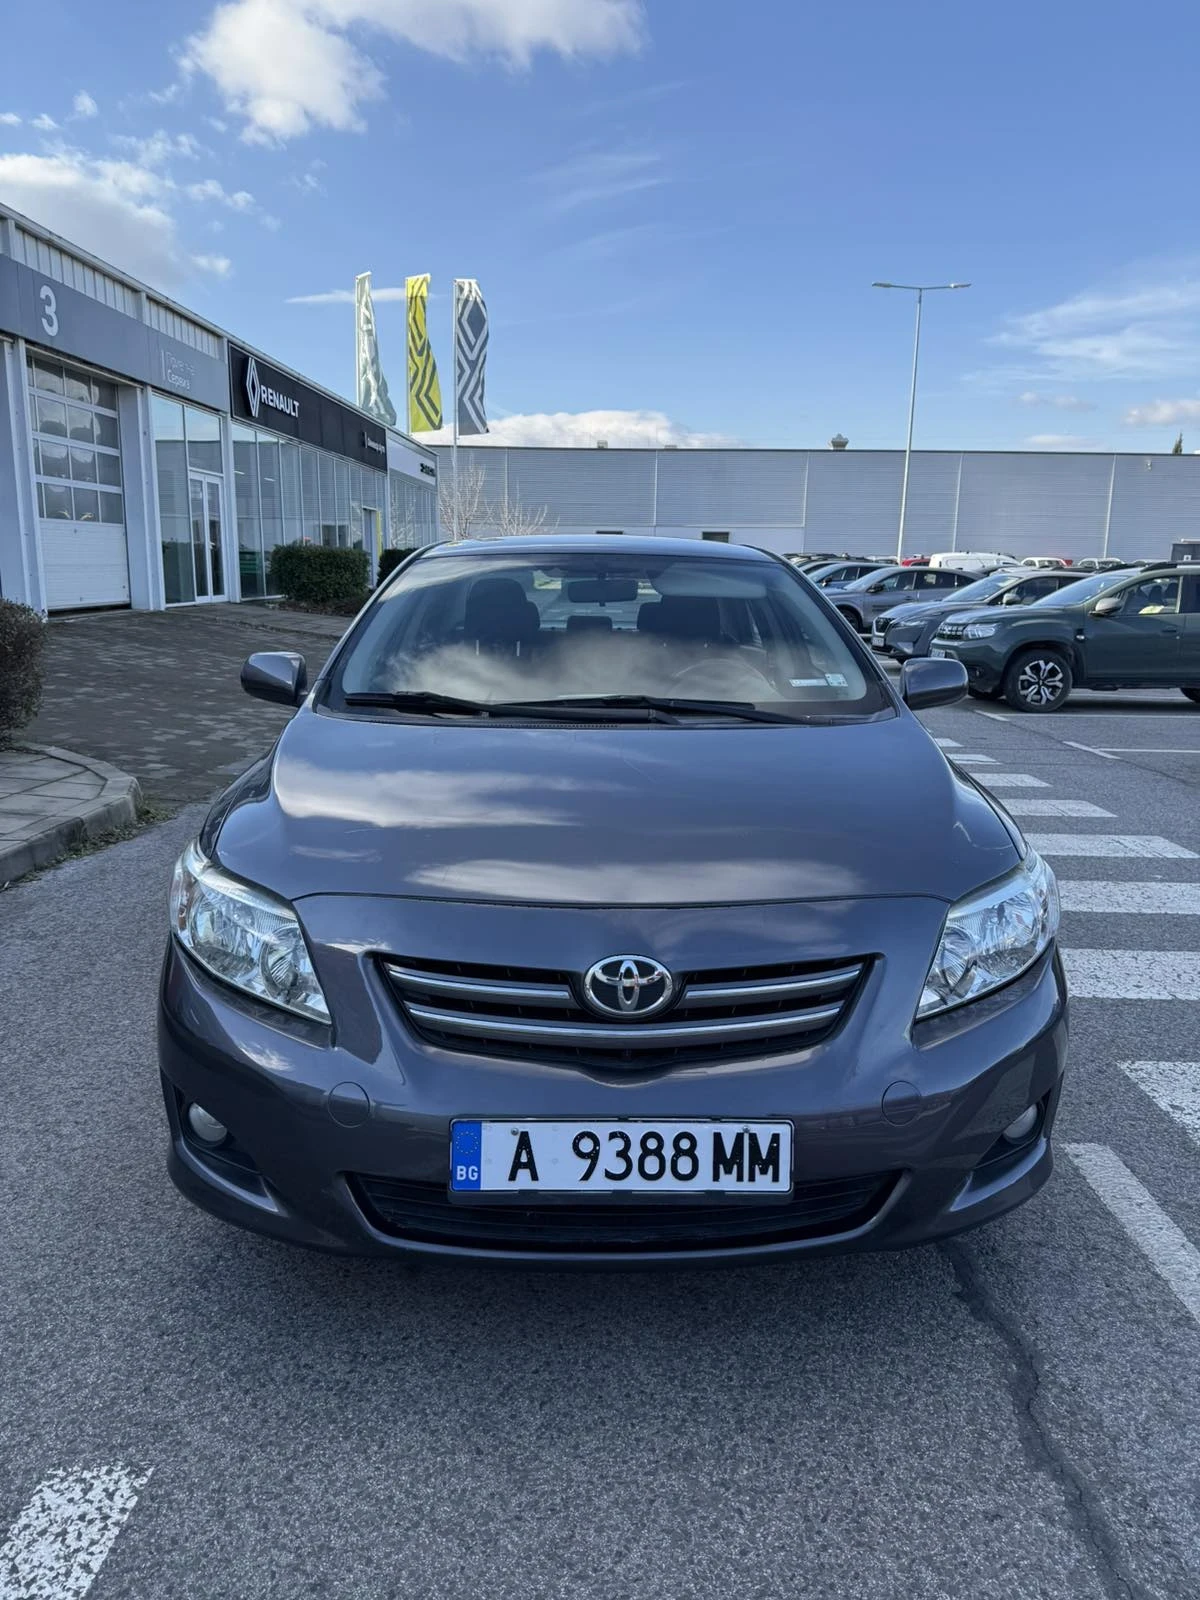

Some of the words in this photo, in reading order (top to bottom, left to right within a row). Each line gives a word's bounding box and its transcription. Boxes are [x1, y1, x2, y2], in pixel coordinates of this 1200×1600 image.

[40, 285, 58, 336] 3
[260, 384, 299, 418] RENAULT
[456, 1166, 478, 1181] BG
[508, 1131, 539, 1182] A
[572, 1131, 699, 1182] 9388
[712, 1132, 780, 1182] MM
